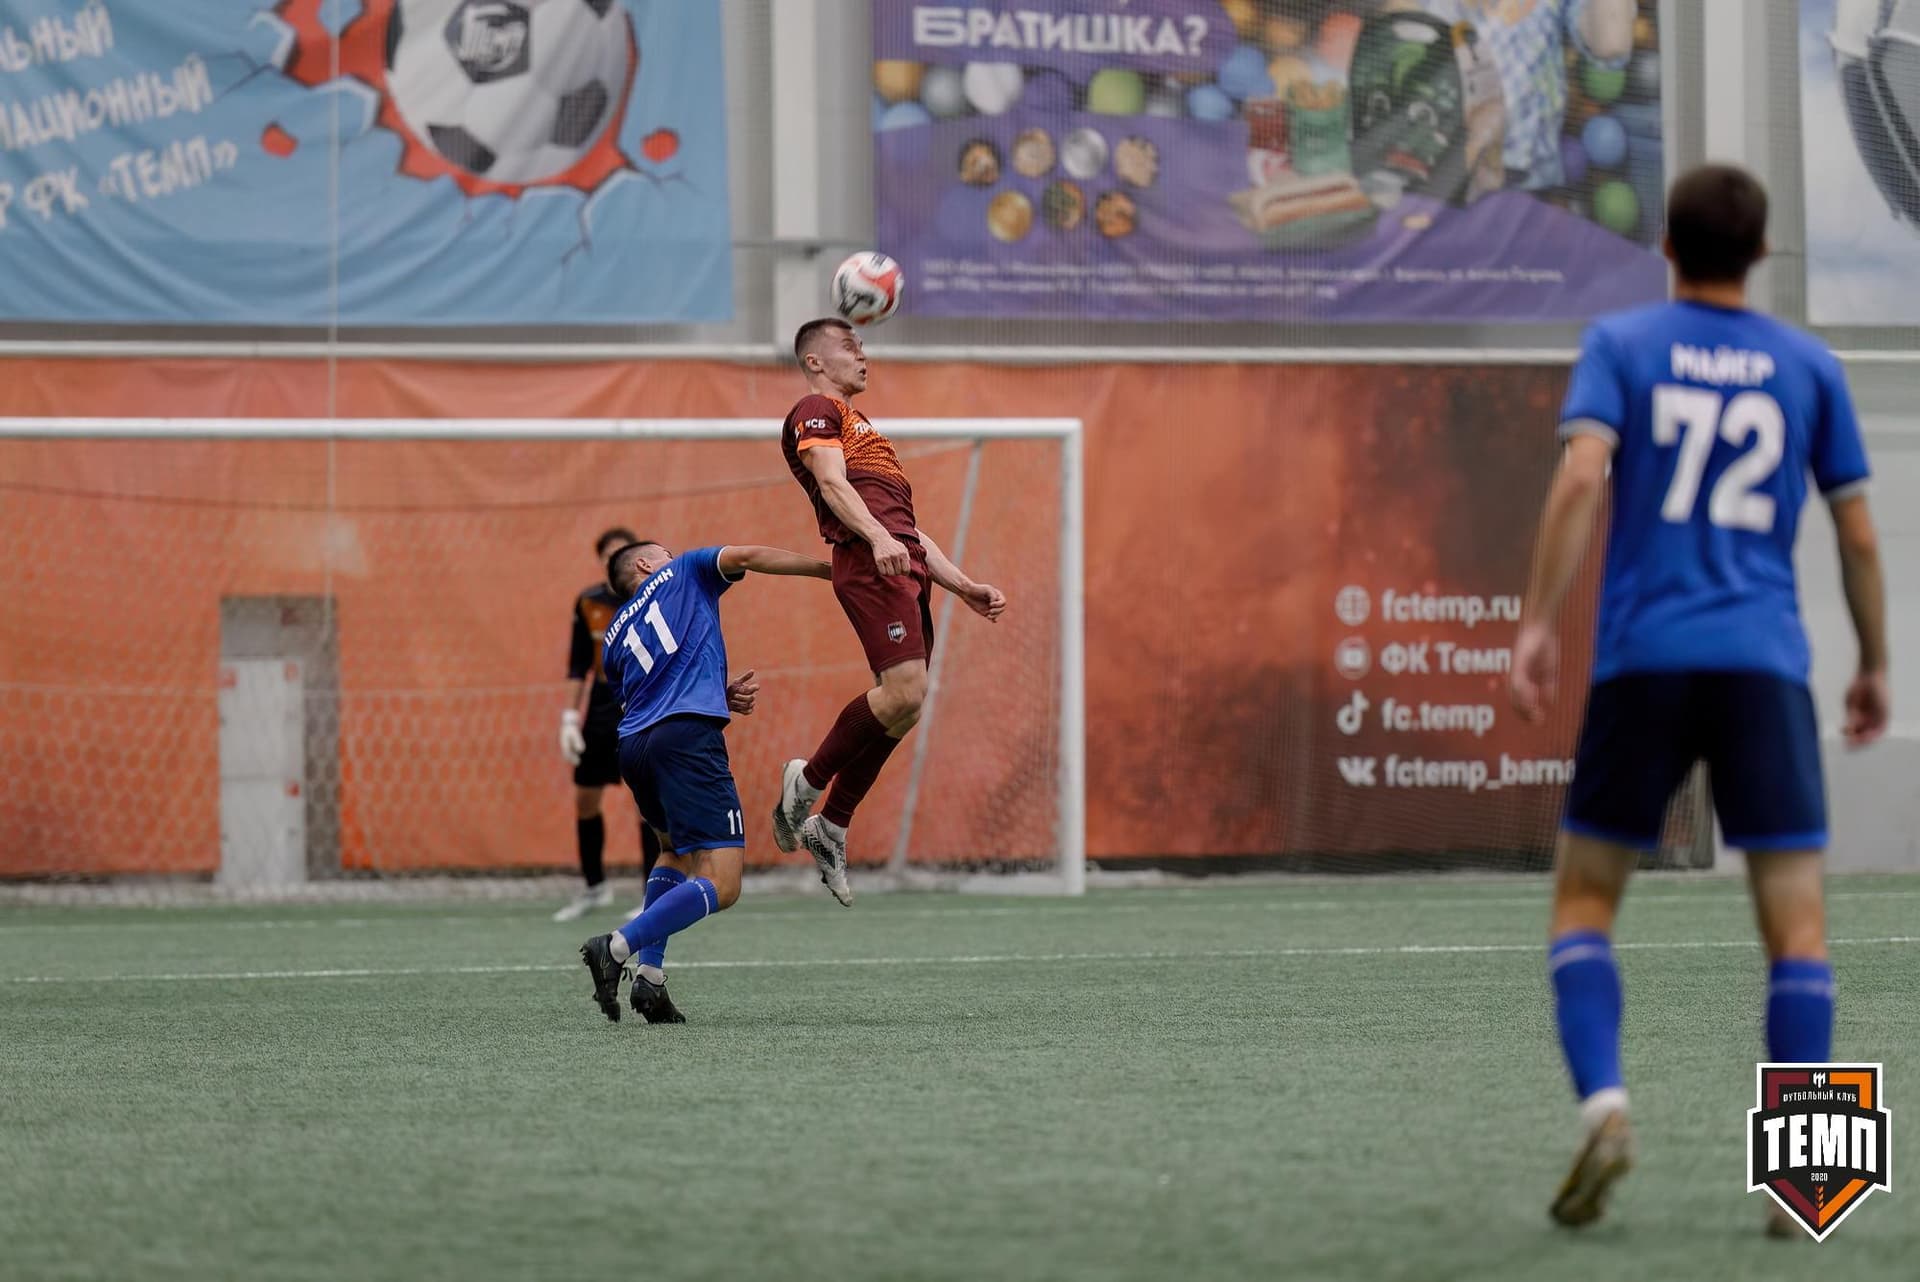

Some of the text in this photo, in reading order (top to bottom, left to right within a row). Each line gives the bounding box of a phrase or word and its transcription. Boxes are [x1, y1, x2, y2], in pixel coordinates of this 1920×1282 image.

[0, 0, 114, 72] ЬНЫЙ
[912, 6, 1208, 56] БРАТИШКА?
[23, 161, 89, 221] ФК
[98, 134, 238, 203] «ТЕМП»
[1652, 382, 1786, 534] 72
[1381, 588, 1522, 629] fctemp.ru
[623, 599, 679, 675] 11
[1380, 641, 1512, 675] ФК Темп
[1381, 697, 1495, 737] fc.temp
[727, 809, 743, 835] 11
